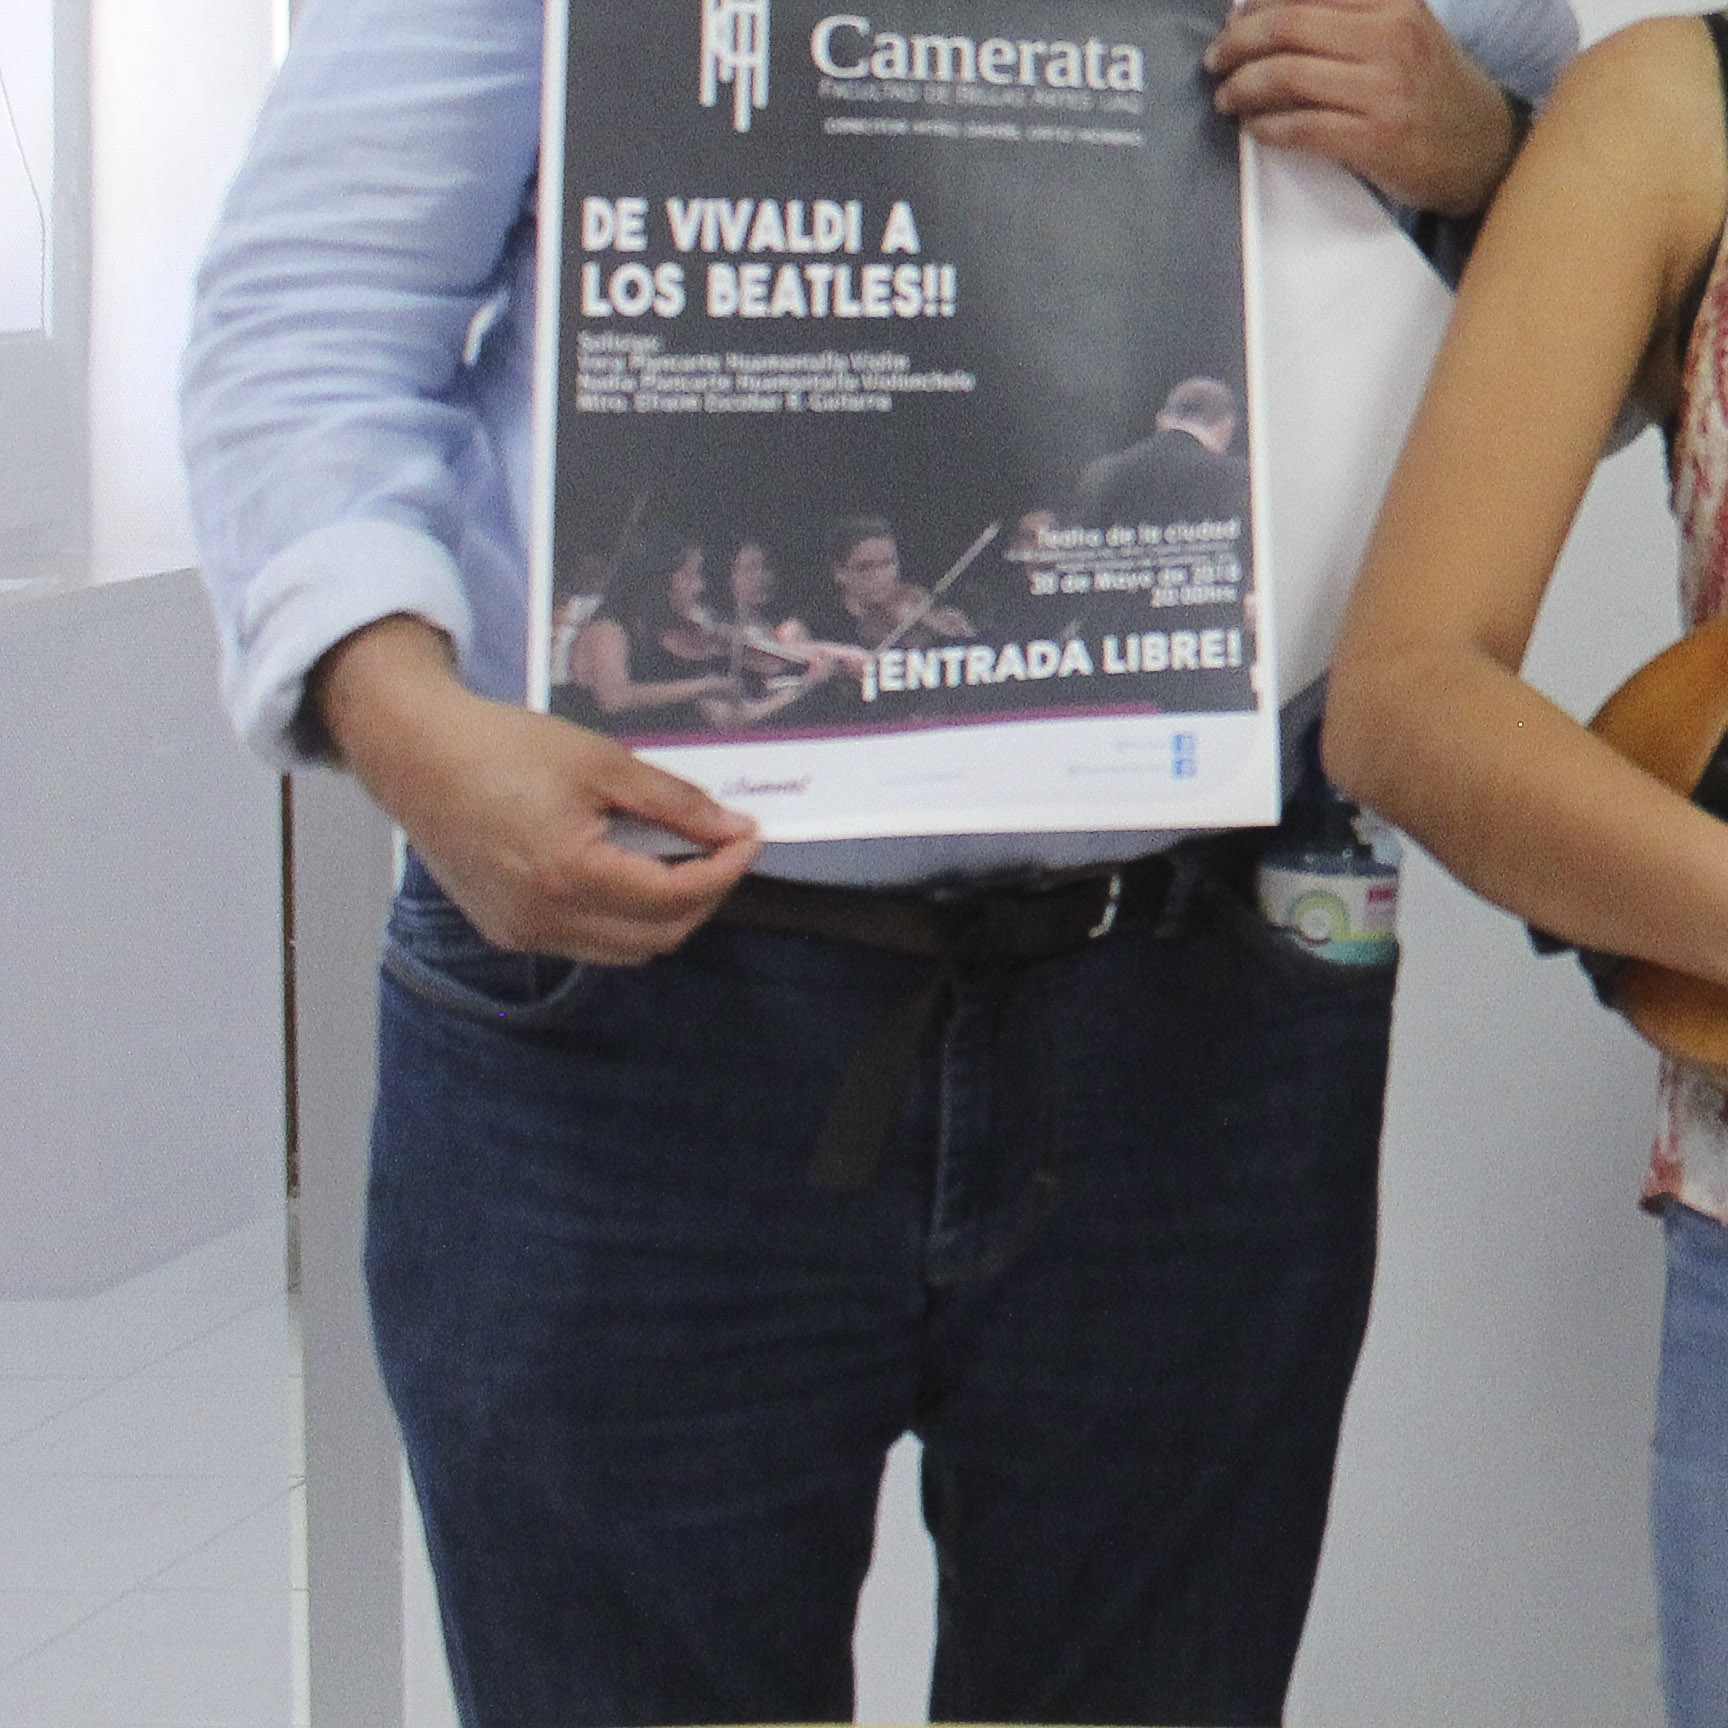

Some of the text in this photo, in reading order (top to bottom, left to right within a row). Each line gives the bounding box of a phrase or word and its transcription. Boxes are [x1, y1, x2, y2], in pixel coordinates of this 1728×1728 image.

[810, 14, 1145, 92] Camerata
[580, 195, 922, 255] DE VIVALDI A
[579, 261, 958, 318] LOS BEATLES!!
[1038, 517, 1242, 548] Teatro de la ciudad
[1059, 572, 1091, 595] de
[1156, 566, 1189, 587] de
[861, 627, 1243, 703] ¡ENTRADA LIBRE!
